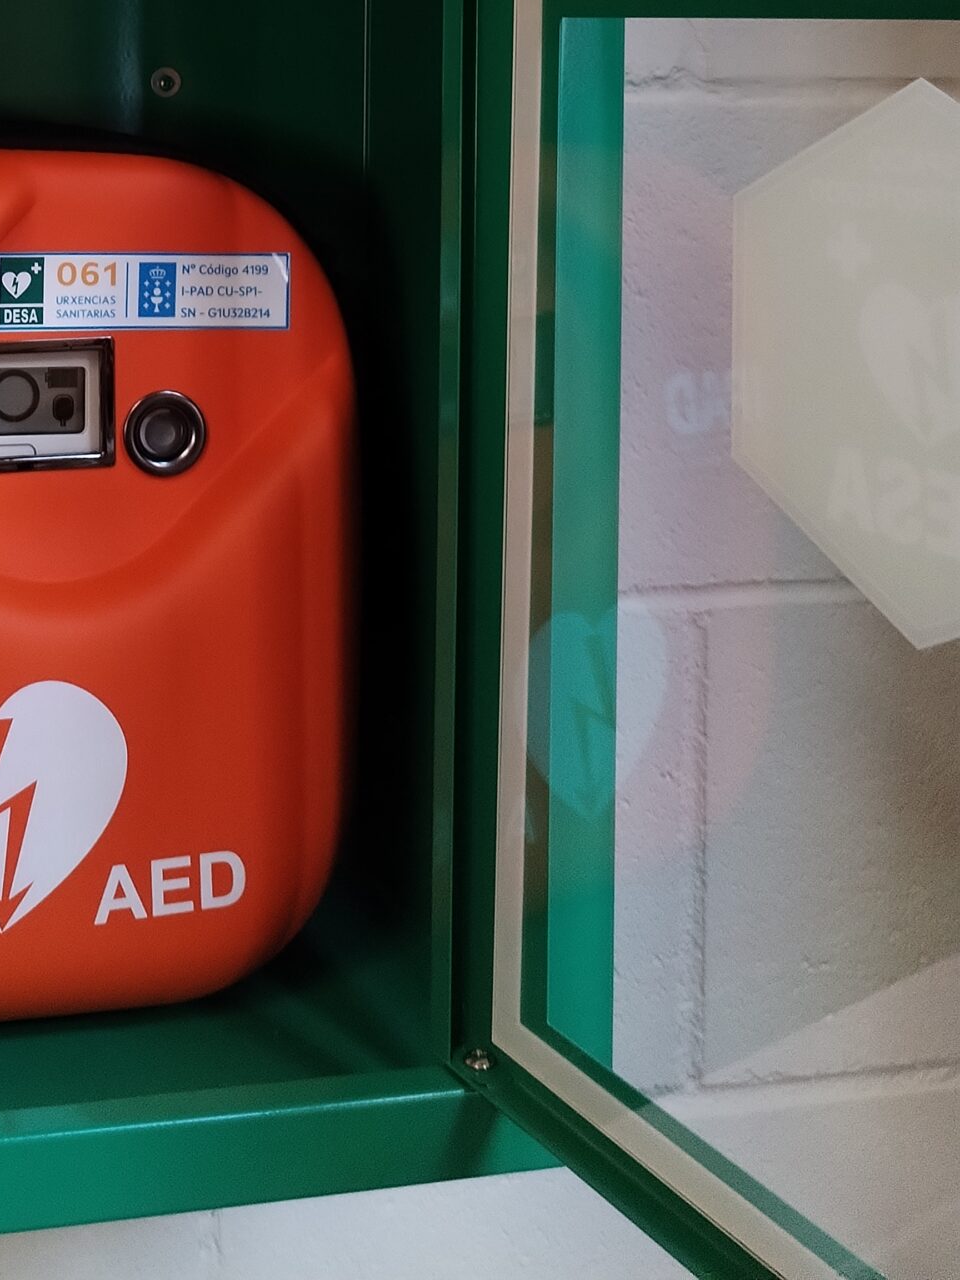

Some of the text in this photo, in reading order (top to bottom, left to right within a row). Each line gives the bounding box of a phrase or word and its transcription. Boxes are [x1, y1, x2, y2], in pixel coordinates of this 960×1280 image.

[56, 261, 117, 286] 061
[182, 264, 269, 277] Nº Código 4199
[181, 286, 263, 297] I-PAD CU-SP1-
[56, 295, 116, 305] URXENCIAS
[4, 308, 38, 324] DESA
[56, 308, 116, 319] SANITARIAS
[181, 307, 196, 318] SN
[208, 307, 270, 319] G1U32B214
[94, 851, 247, 926] AED
